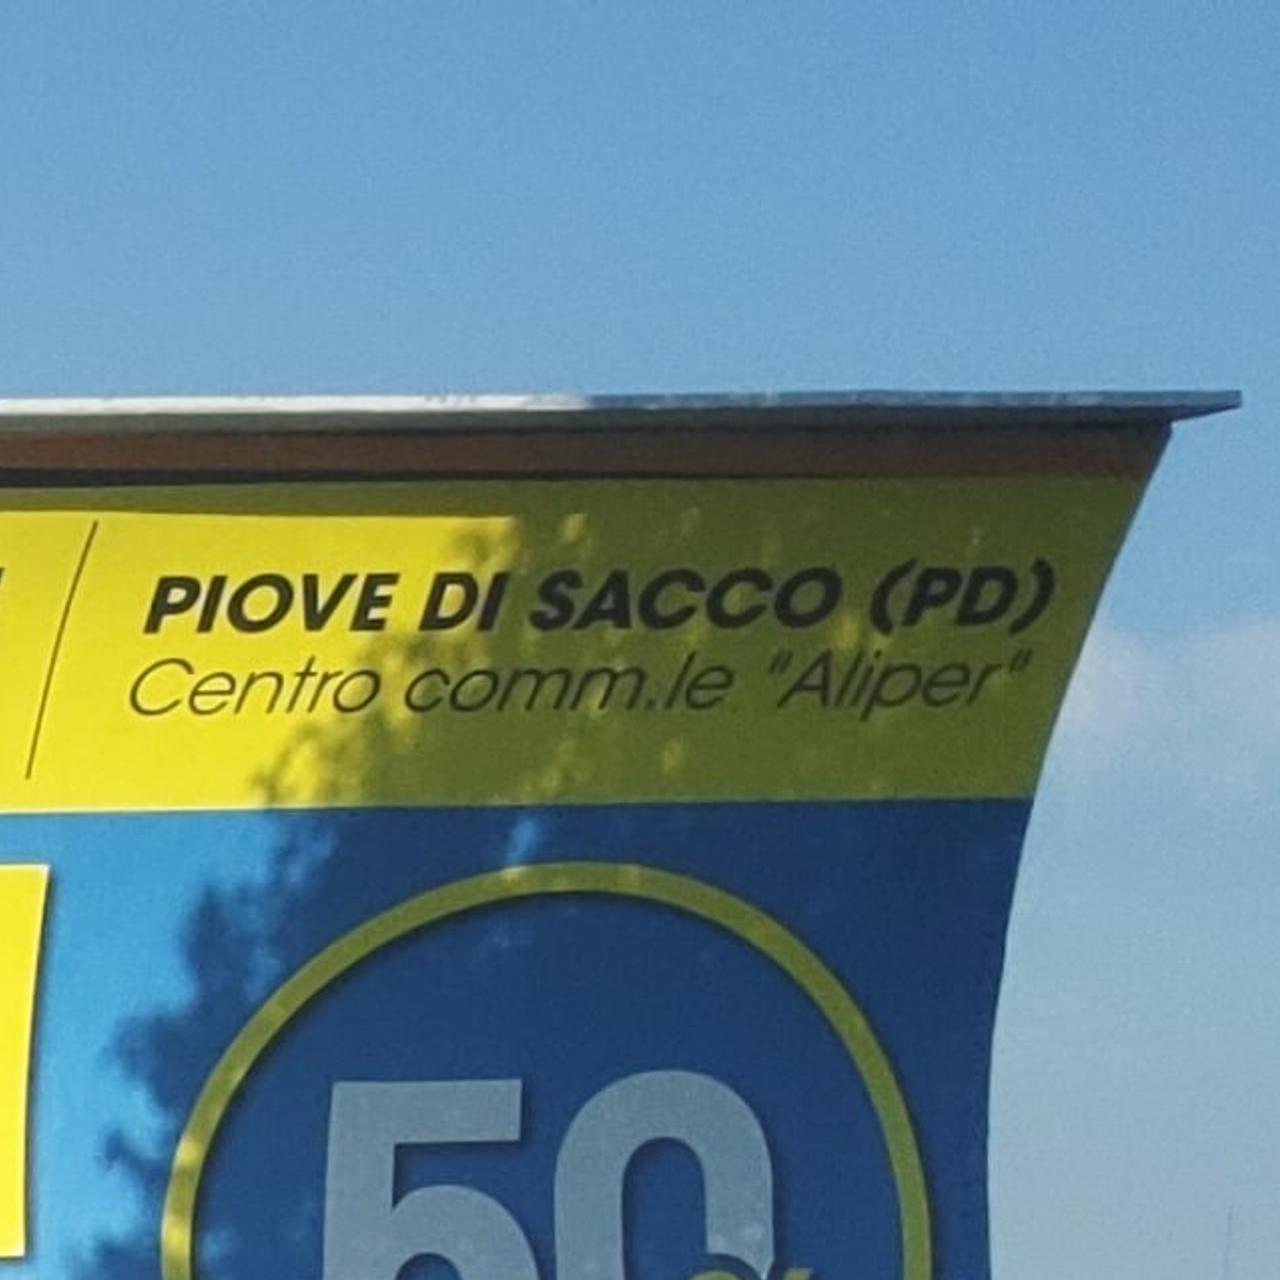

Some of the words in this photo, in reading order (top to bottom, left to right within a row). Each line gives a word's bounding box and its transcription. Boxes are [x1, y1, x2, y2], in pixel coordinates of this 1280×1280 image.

[142, 571, 397, 634] PIOVE
[419, 573, 510, 632] DI
[530, 567, 842, 630] SACCO
[869, 559, 1057, 632] (PD)
[129, 657, 382, 716] Centro
[403, 650, 734, 715] comm.le
